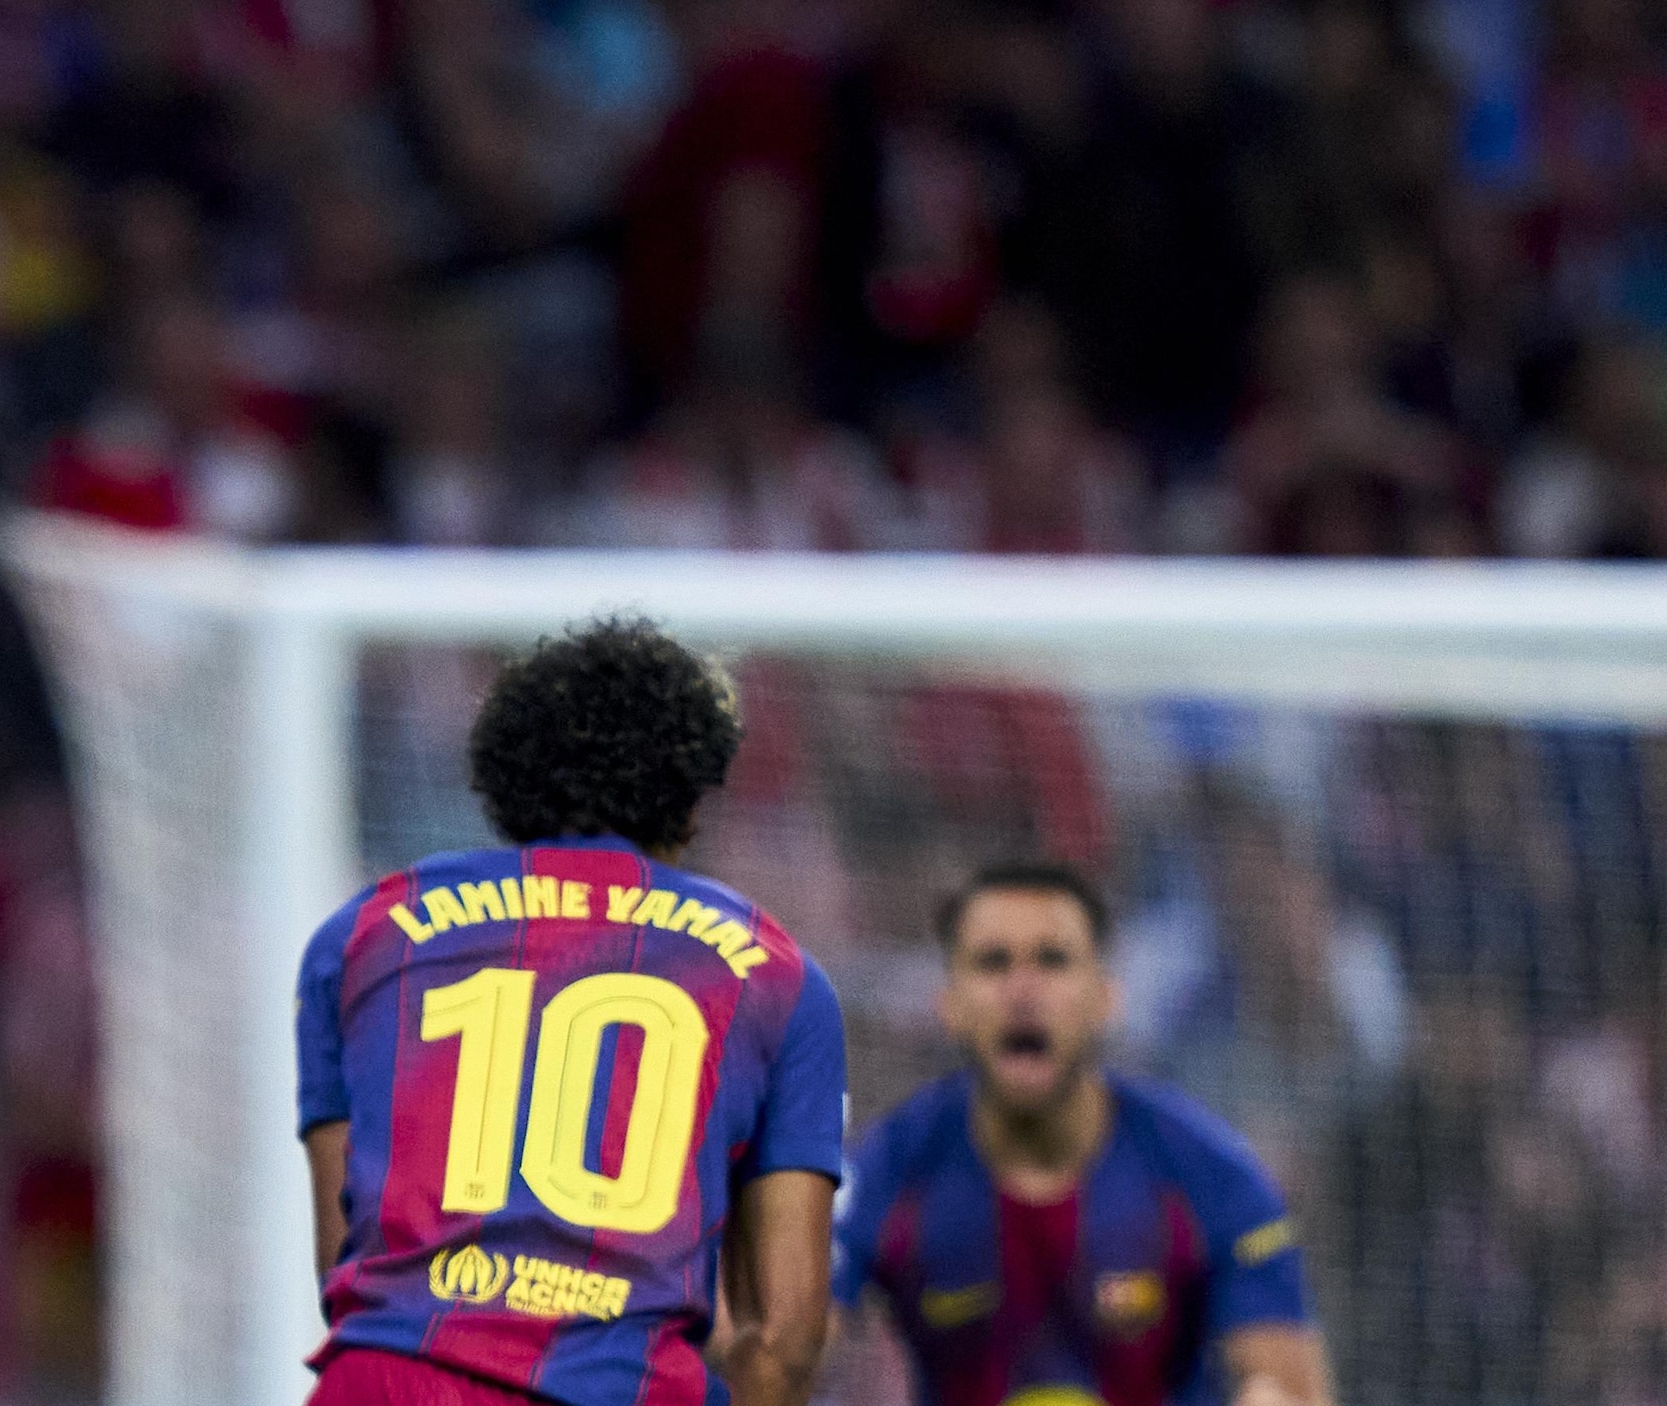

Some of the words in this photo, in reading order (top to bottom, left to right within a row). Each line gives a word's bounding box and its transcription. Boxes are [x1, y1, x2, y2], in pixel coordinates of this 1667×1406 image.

[387, 874, 593, 944] LAMINE
[605, 884, 771, 979] YAMAL
[420, 967, 710, 1234] 10
[513, 1254, 632, 1300] UNHCR
